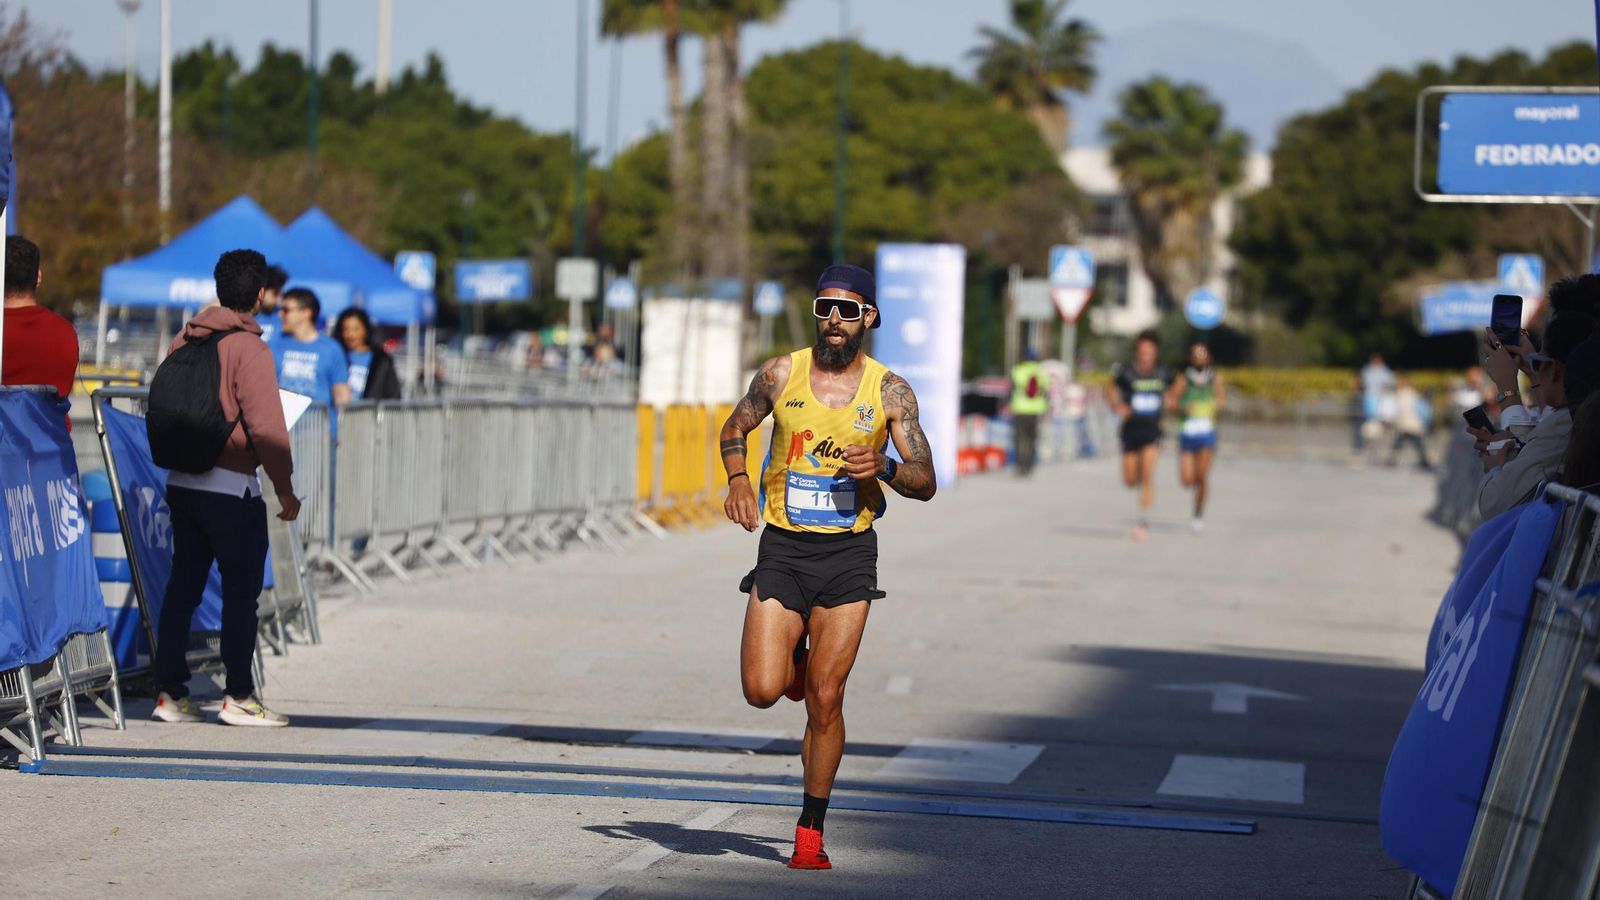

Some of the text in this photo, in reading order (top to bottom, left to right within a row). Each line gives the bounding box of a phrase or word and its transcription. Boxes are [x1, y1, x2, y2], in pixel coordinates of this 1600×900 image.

[1515, 105, 1580, 122] mayoral
[1475, 144, 1600, 166] FEDERADO
[785, 398, 804, 409] vive
[812, 436, 842, 459] Álo
[812, 492, 830, 507] 11
